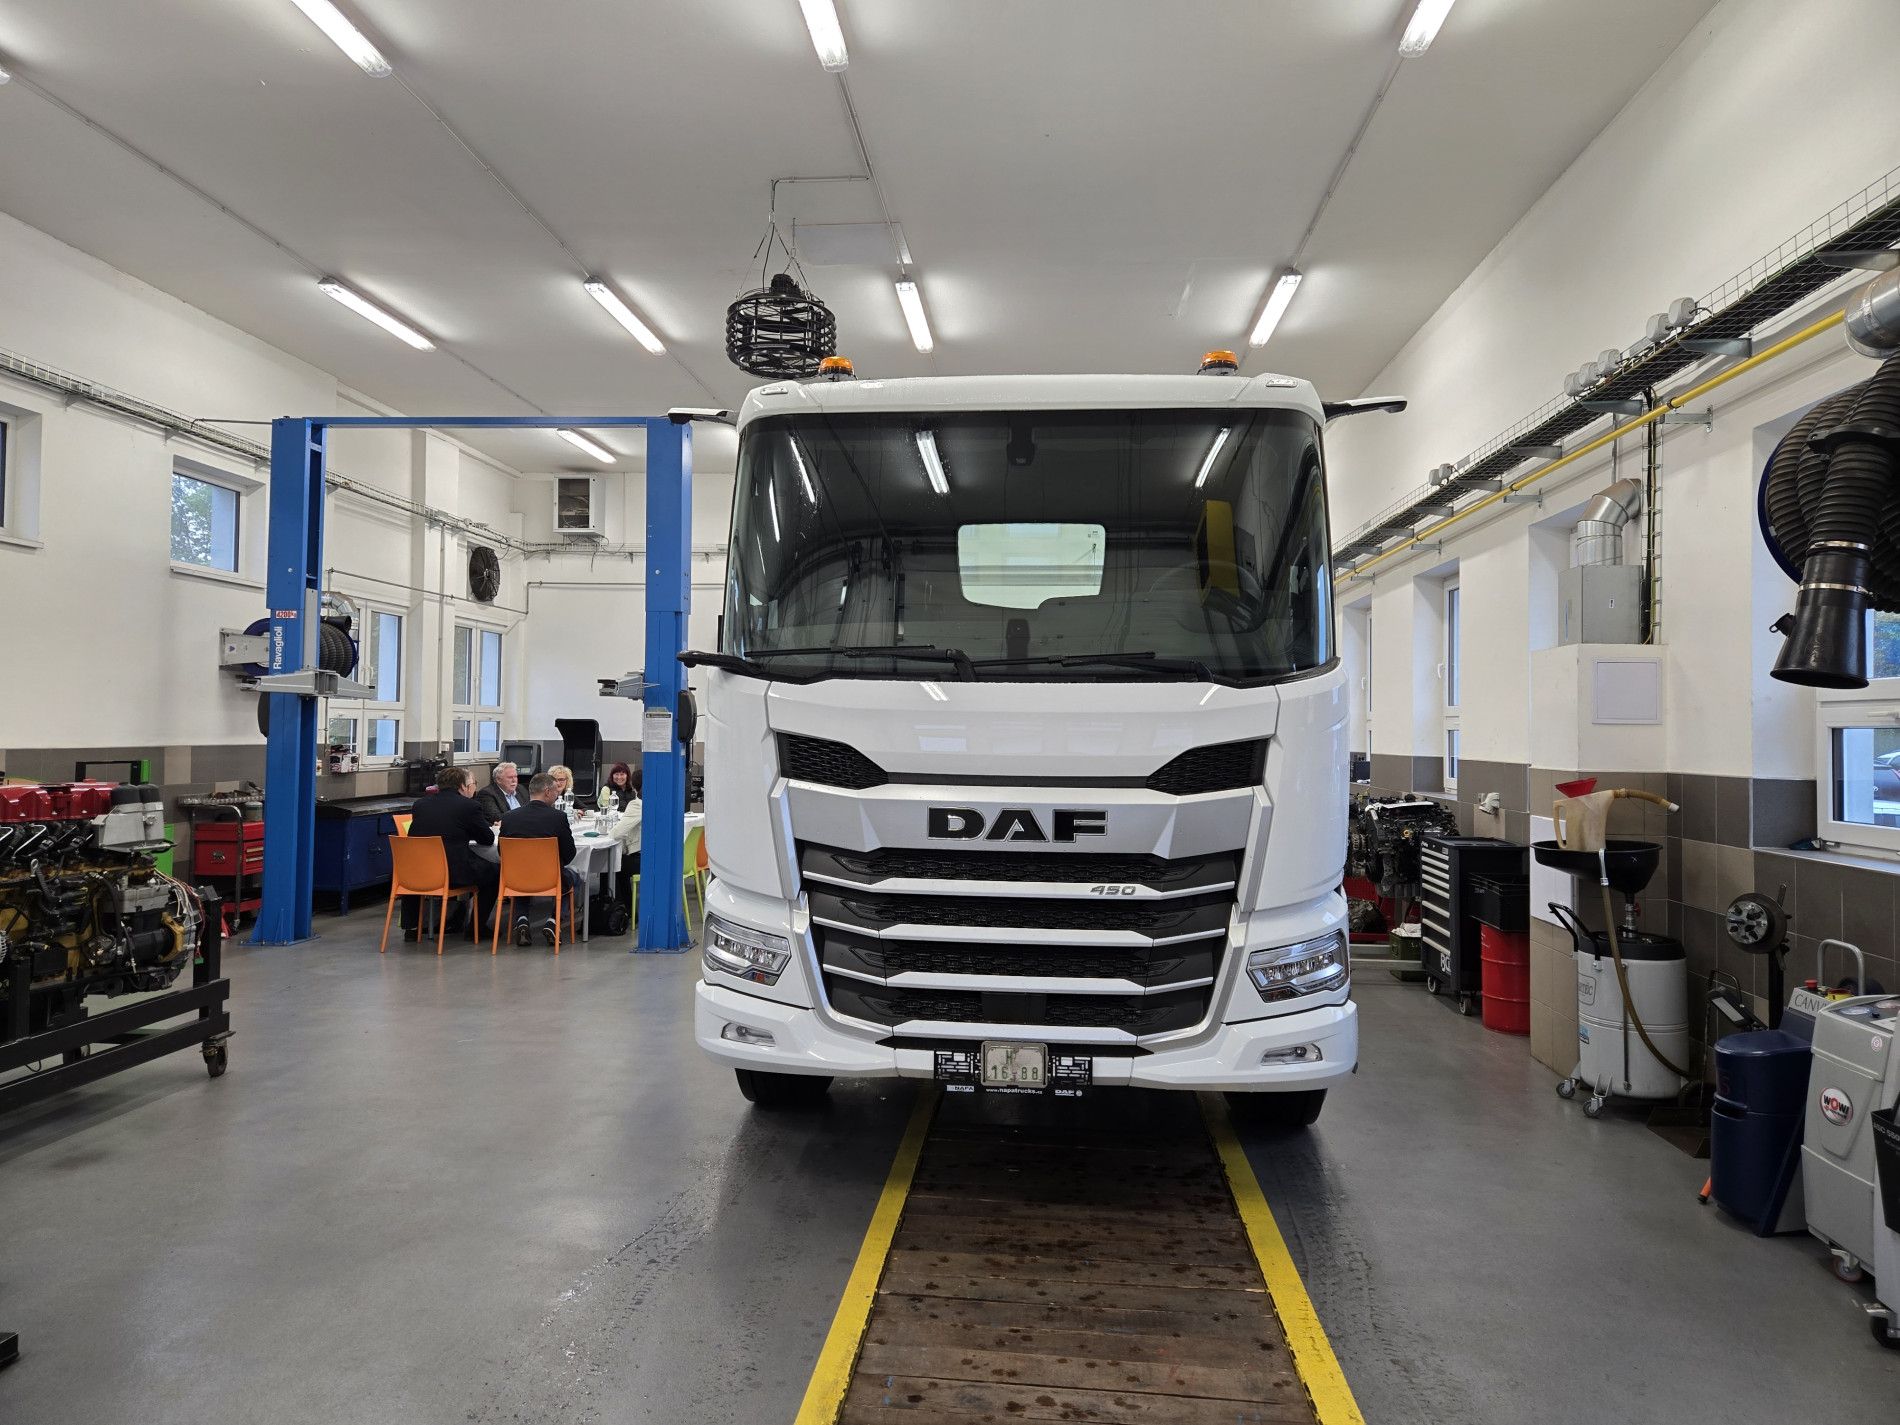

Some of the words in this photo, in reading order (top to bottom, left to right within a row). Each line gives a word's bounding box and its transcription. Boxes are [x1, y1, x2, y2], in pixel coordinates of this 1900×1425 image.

[273, 626, 284, 670] Ravaglioli
[927, 806, 1108, 843] DAF
[1090, 885, 1137, 896] 450
[1794, 993, 1827, 1012] CANV
[991, 1065, 1009, 1079] 16
[1021, 1066, 1039, 1080] 88
[1823, 1094, 1849, 1115] WOW!
